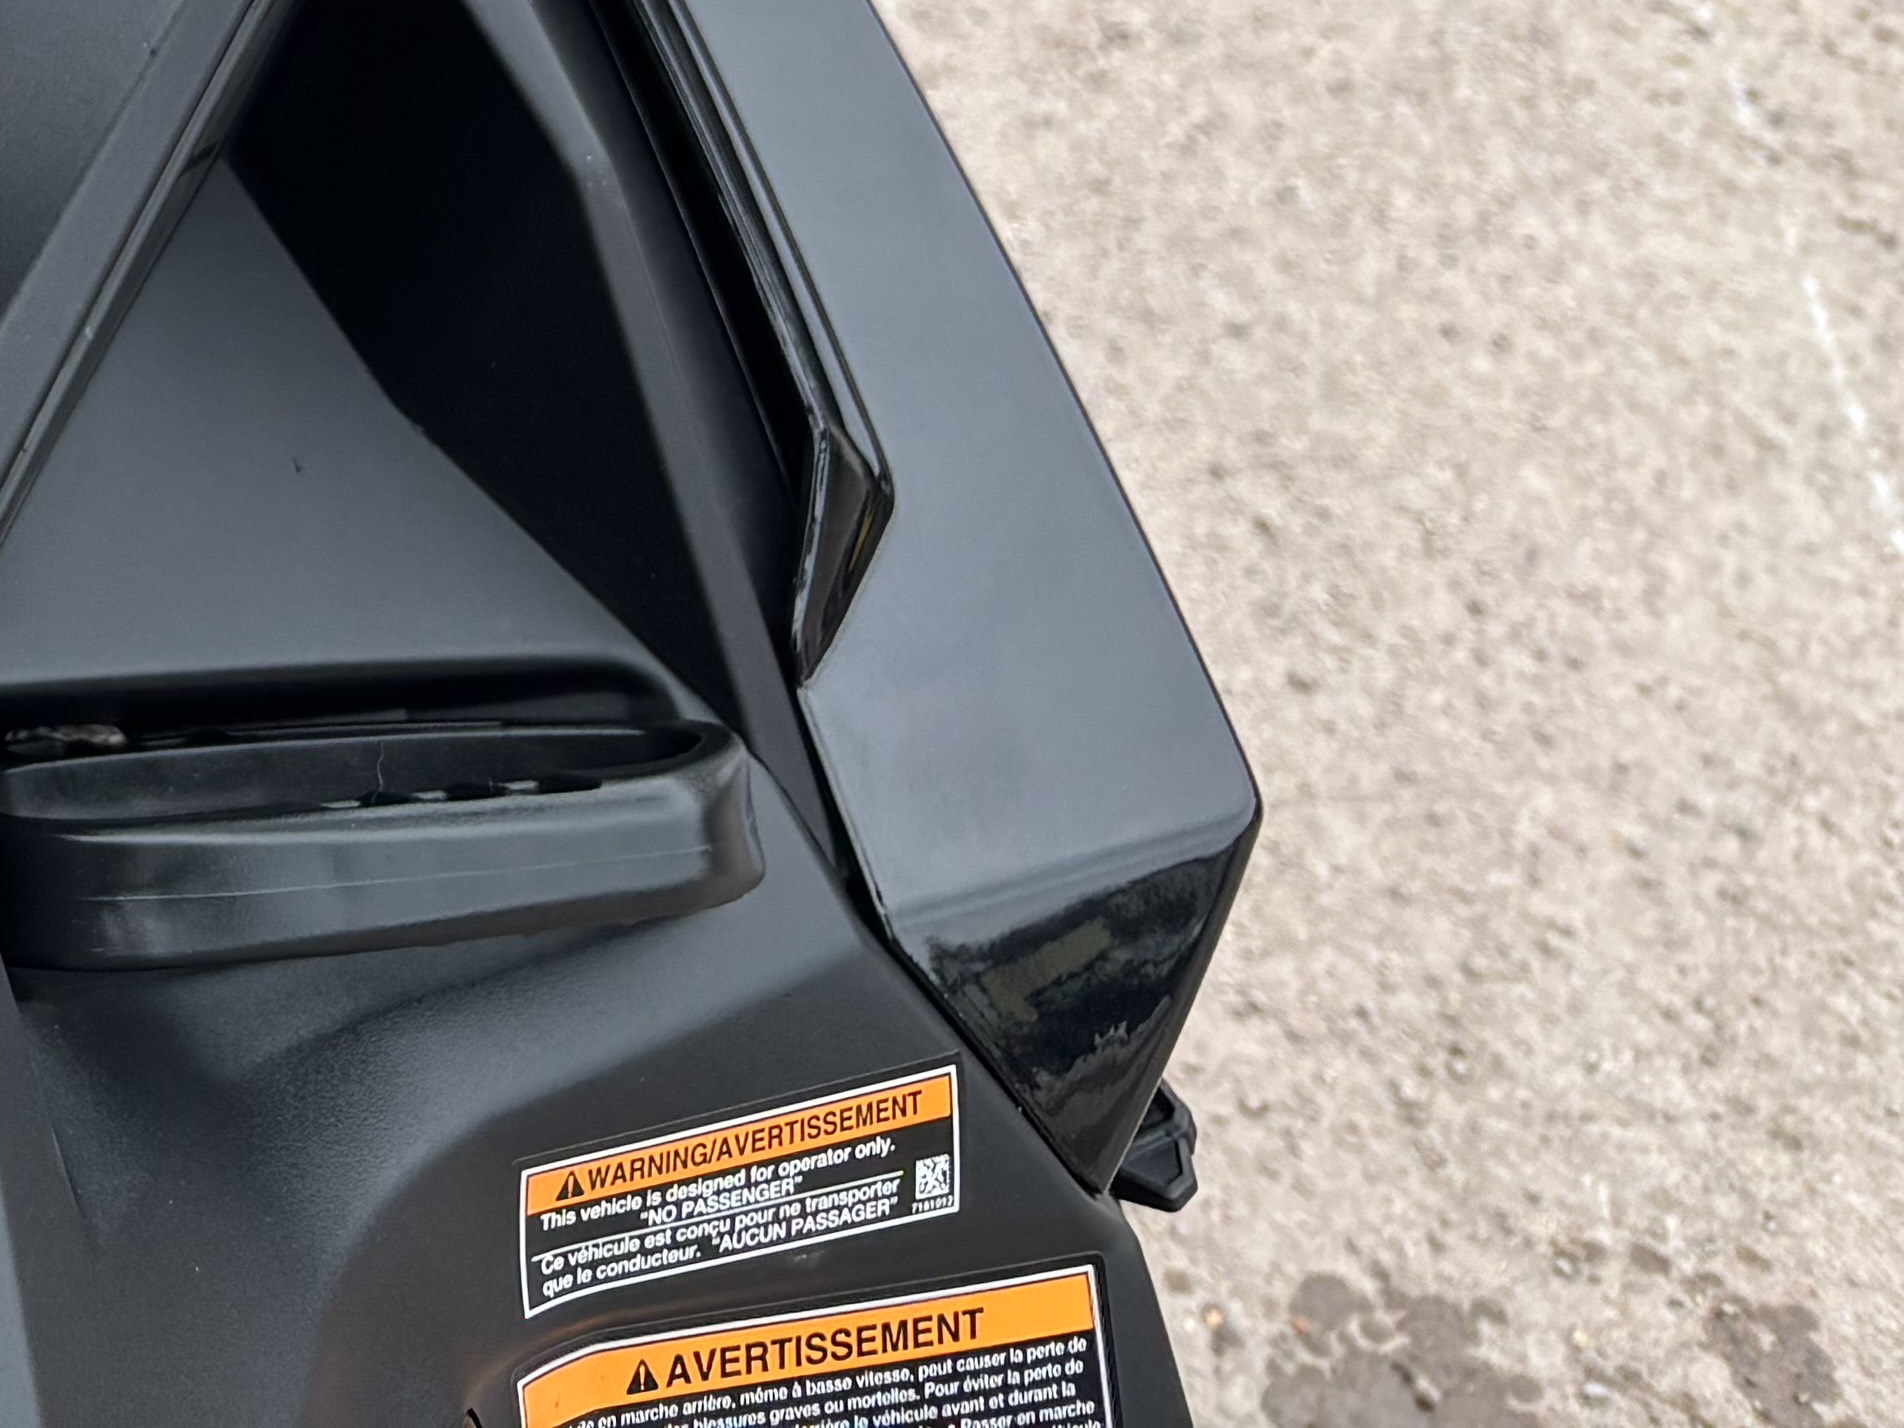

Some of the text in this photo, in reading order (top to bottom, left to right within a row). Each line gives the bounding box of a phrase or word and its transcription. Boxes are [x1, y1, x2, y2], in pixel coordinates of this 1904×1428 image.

[588, 1090, 923, 1191] WARNING/AVERTISSEMENT
[540, 1136, 896, 1231] This vehicle is designed for operator only.
[541, 1179, 900, 1276] Ce véhicule est conçu pour ne transporter
[542, 1276, 573, 1299] que
[577, 1267, 592, 1285] le
[596, 1245, 701, 1280] conducteur.
[666, 1307, 984, 1388] AVERTISSEMENT
[918, 1359, 952, 1382] peut
[956, 1351, 1006, 1373] causer
[1009, 1347, 1023, 1364] la
[1027, 1341, 1065, 1364] perte
[1067, 1336, 1087, 1355] de
[824, 1399, 844, 1414] ou
[924, 1381, 960, 1400] Pour
[1007, 1369, 1021, 1385] la
[1024, 1362, 1061, 1386] perte
[1065, 1358, 1084, 1375] de
[942, 1396, 984, 1418] avant
[989, 1392, 1004, 1410] et
[1008, 1382, 1058, 1407] durant
[1062, 1381, 1076, 1397] la
[1039, 1399, 1095, 1422] marche
